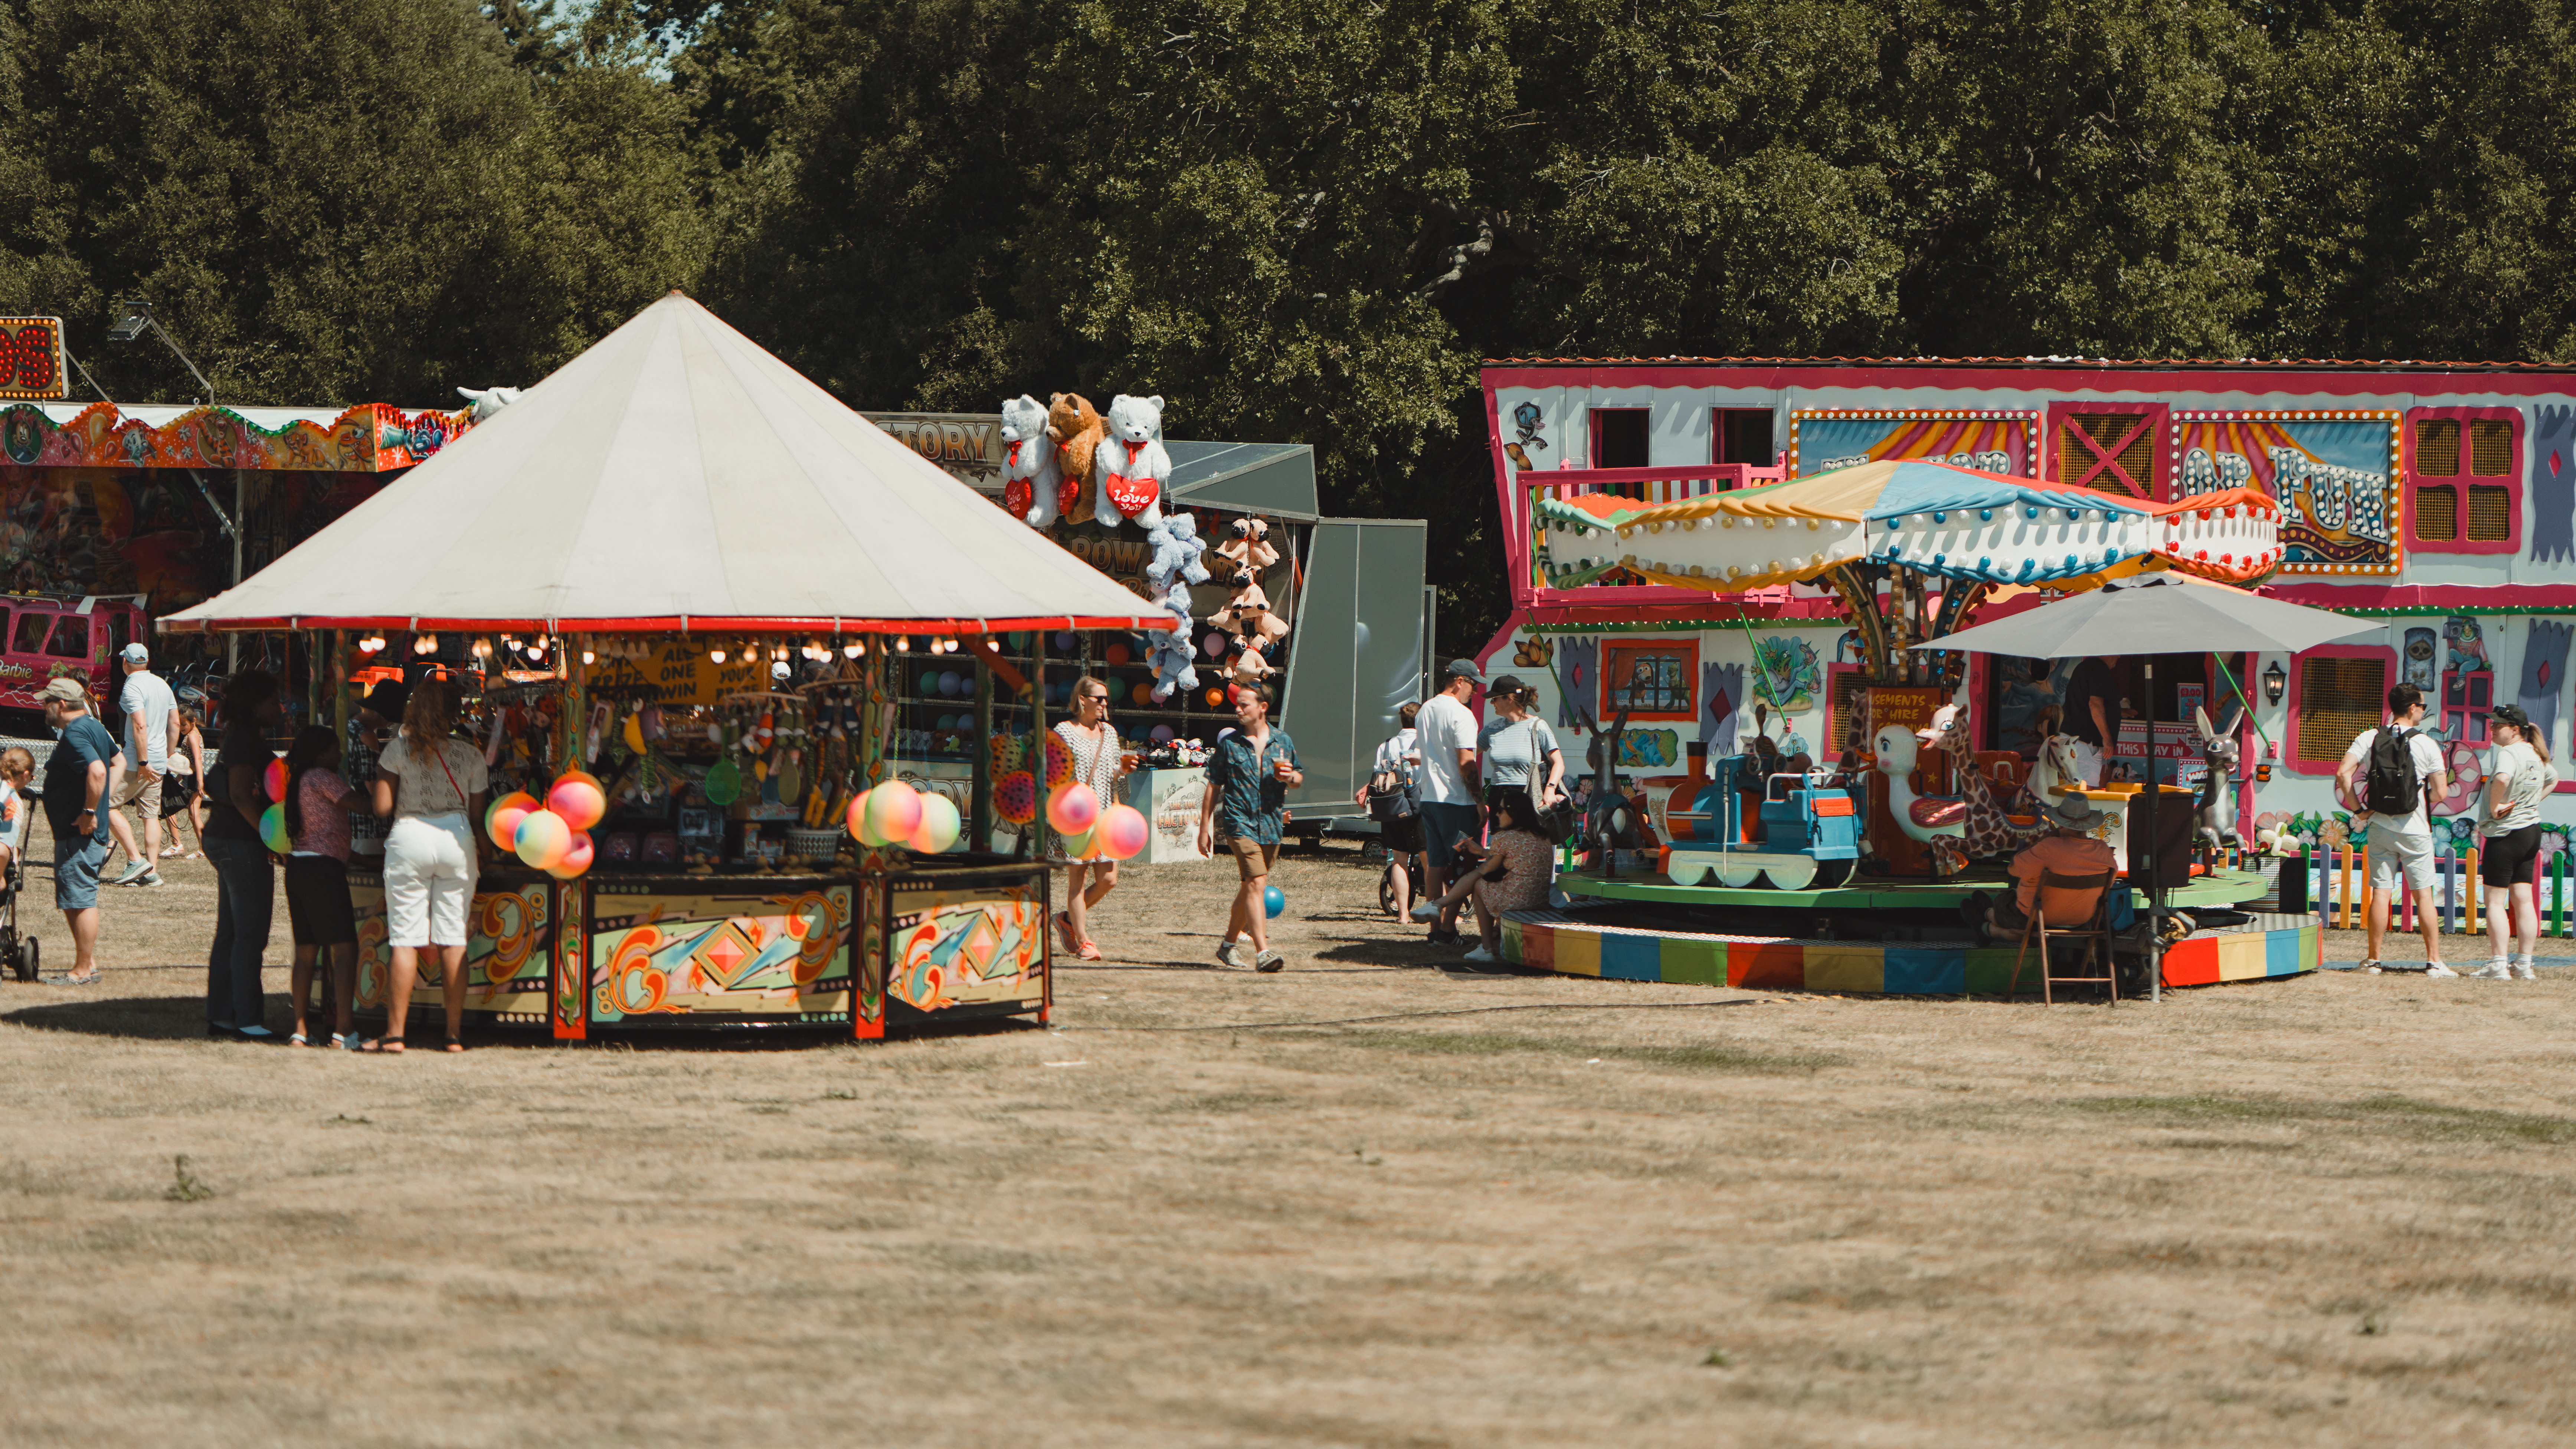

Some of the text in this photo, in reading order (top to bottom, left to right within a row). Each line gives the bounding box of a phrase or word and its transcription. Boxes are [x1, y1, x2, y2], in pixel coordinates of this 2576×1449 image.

[876, 423, 990, 461] TORY
[1007, 494, 1021, 506] love
[1114, 489, 1149, 504] love
[2268, 446, 2388, 544] FUN
[663, 648, 695, 663] ALL
[661, 663, 695, 682] ONE
[658, 682, 697, 700] WIN
[1889, 709, 1919, 720] HIRE
[1168, 799, 1197, 810] THE TOY
